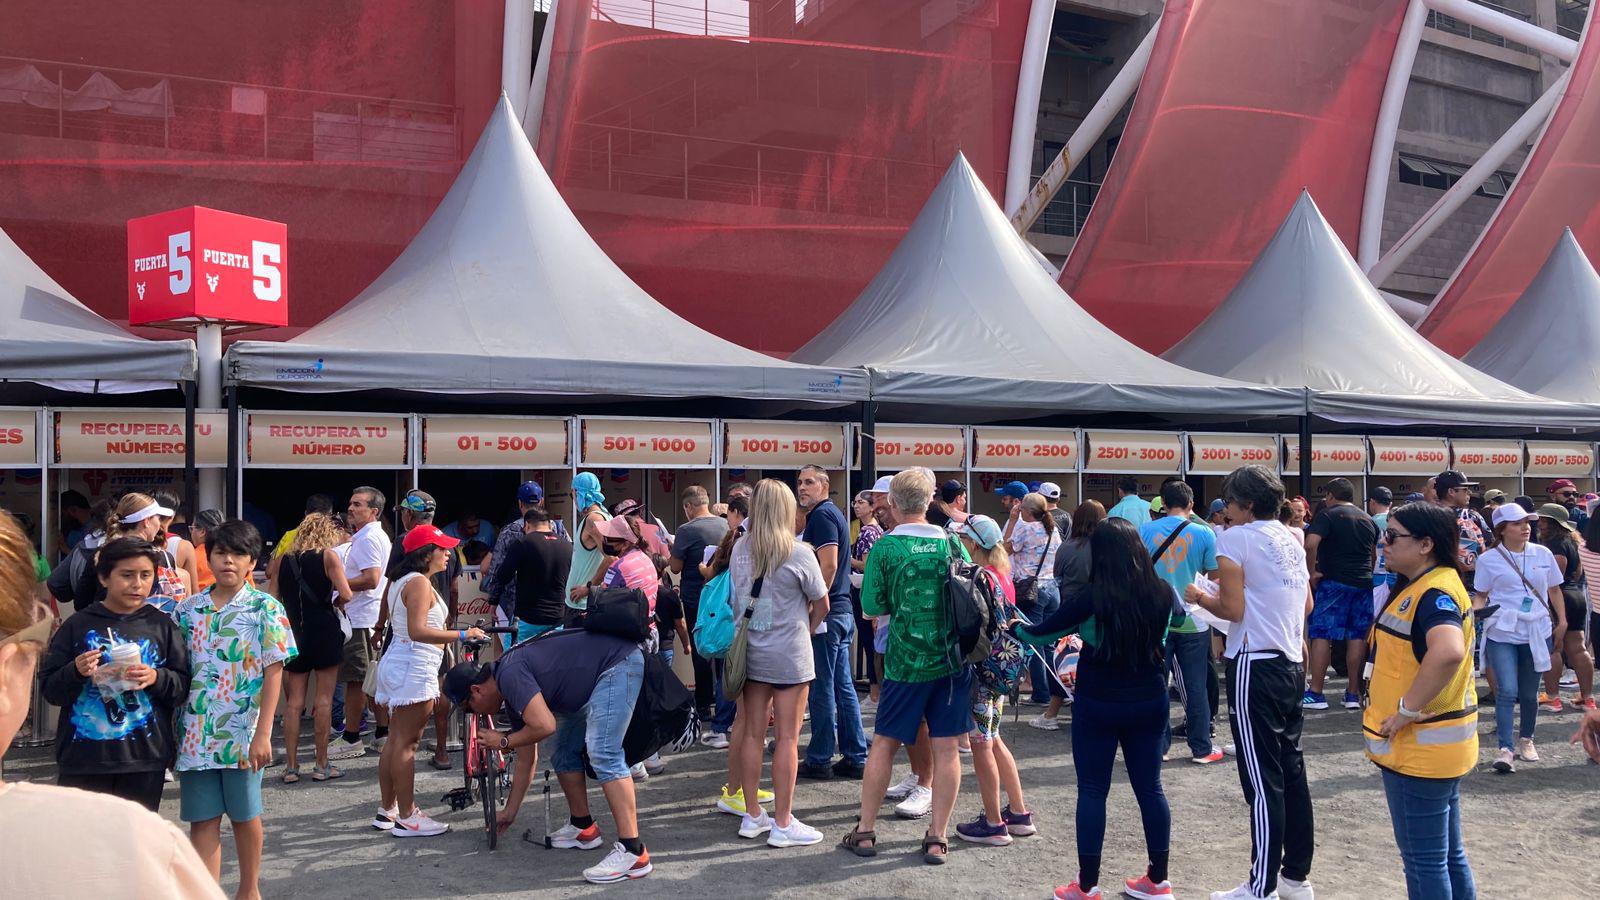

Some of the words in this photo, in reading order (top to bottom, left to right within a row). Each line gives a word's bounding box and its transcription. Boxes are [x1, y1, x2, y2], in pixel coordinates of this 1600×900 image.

[134, 253, 167, 272] PUERTA
[168, 231, 191, 295] 5
[203, 248, 249, 269] PUERTA
[252, 240, 281, 302] 5
[80, 423, 183, 436] RECUPERA
[269, 425, 362, 438] RECUPERA
[366, 426, 387, 438] TU
[106, 440, 186, 454] NÚMERO
[292, 442, 366, 456] NÚMERO
[457, 436, 480, 451] 01
[497, 436, 538, 451] 500
[603, 436, 635, 451] 501
[651, 437, 696, 452] 1000
[741, 438, 779, 453] 1001
[793, 439, 832, 453] 1500
[874, 442, 901, 456] 501
[914, 442, 956, 456] 2000
[985, 444, 1021, 458] 2001
[1032, 444, 1070, 458] 2500
[1097, 446, 1129, 460] 2501
[1140, 447, 1175, 461] 3000
[1201, 448, 1232, 461] 3001
[1241, 448, 1273, 461] 3500
[1331, 450, 1361, 462] 4000
[1380, 450, 1407, 462] 4001
[1415, 451, 1444, 463] 4500
[1459, 453, 1484, 465] 4501
[1491, 453, 1518, 465] 5000
[1534, 454, 1559, 466] 5001
[1565, 455, 1590, 466] 5500
